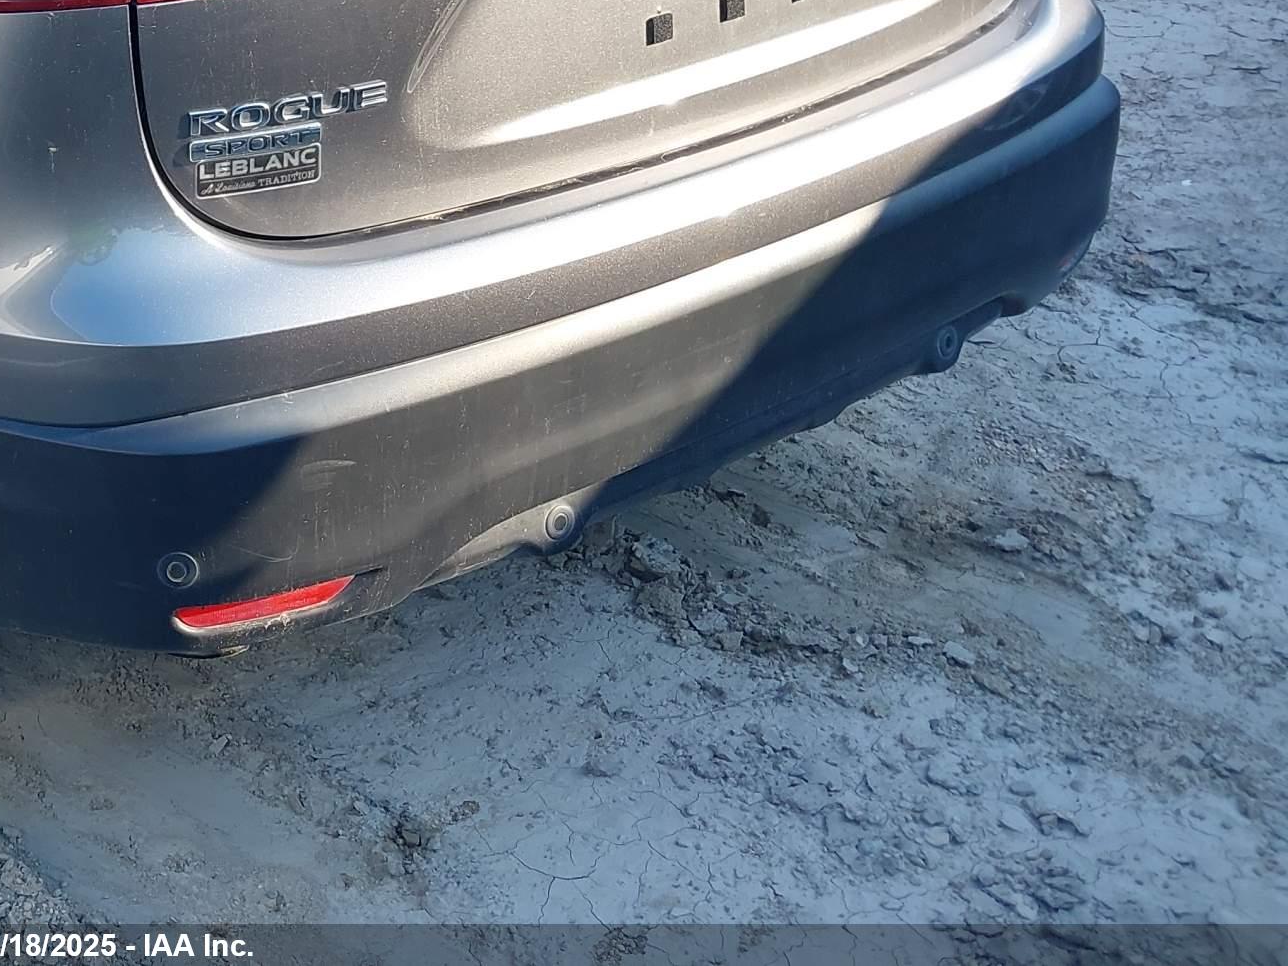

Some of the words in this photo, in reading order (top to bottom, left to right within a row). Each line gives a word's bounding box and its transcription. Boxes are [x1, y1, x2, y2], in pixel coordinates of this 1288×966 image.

[188, 80, 388, 136] ROGUE
[205, 131, 311, 157] SPORT
[199, 148, 317, 180] LEBLANC
[257, 171, 316, 187] TRADITION
